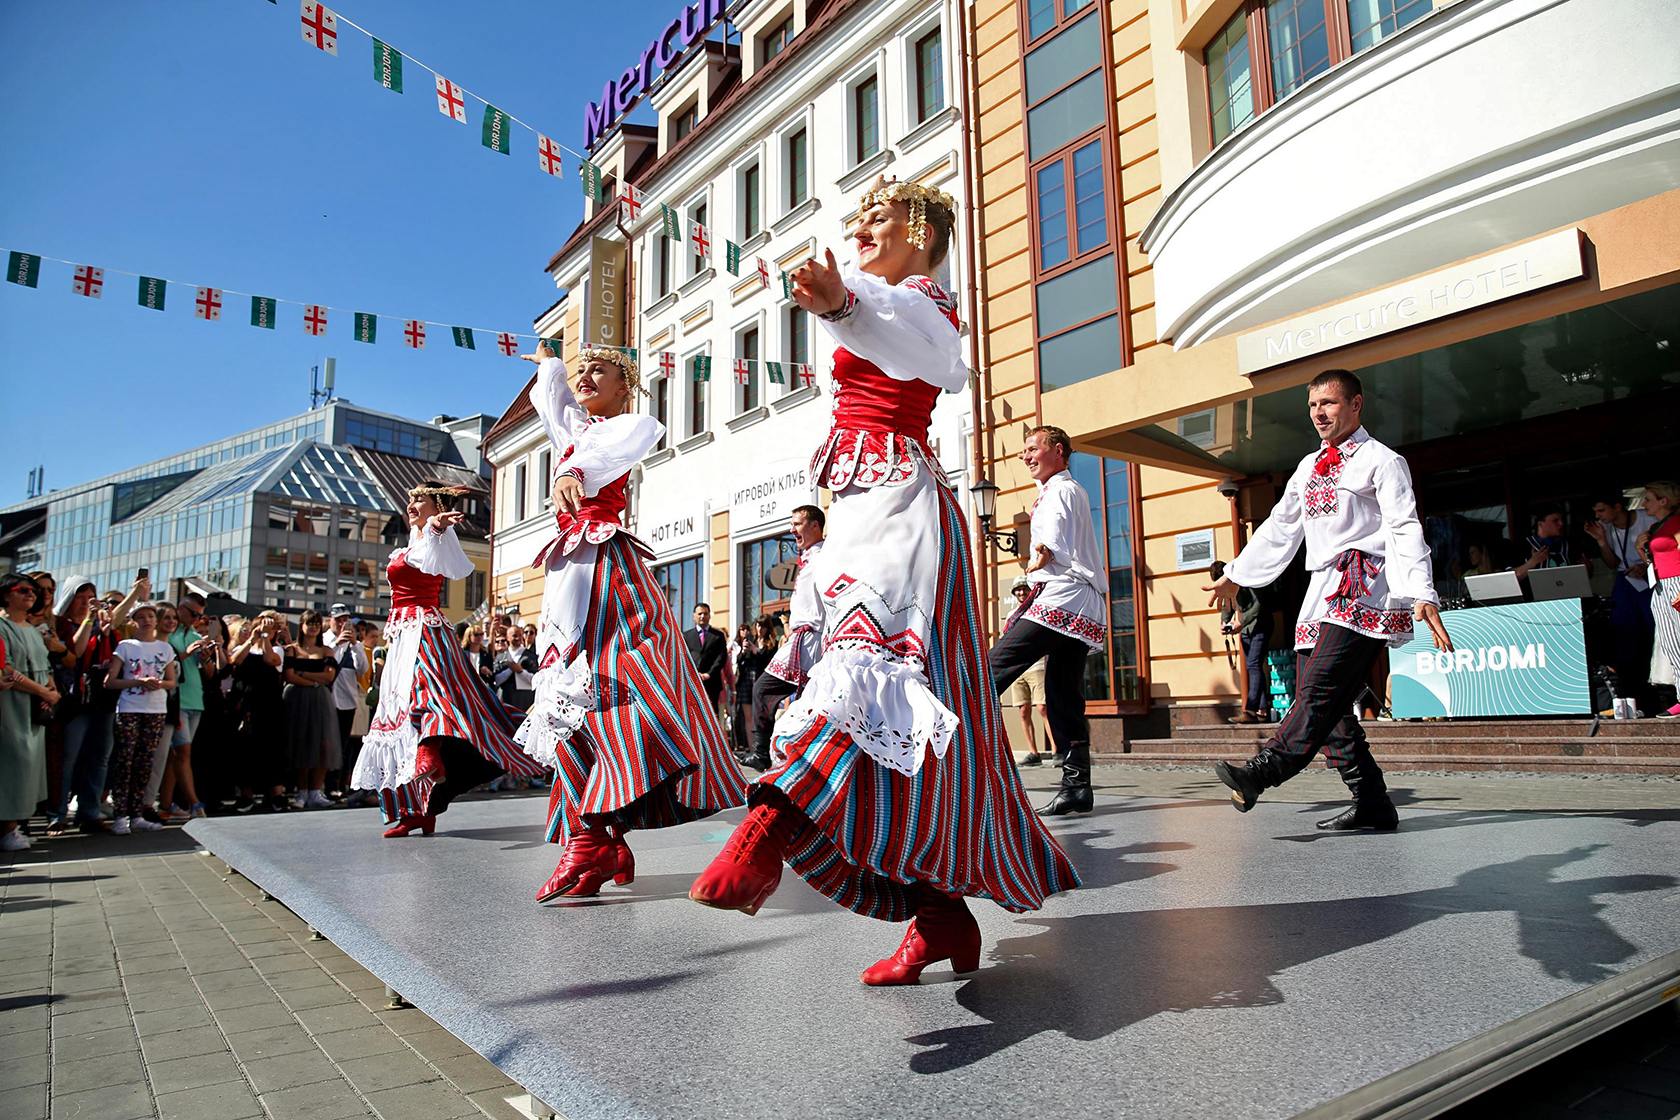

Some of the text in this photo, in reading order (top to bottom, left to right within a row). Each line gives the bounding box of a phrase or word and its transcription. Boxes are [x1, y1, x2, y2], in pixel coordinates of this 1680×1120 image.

[382, 43, 392, 89] BORJOMI
[491, 110, 503, 151] BORJOMI
[588, 162, 596, 200] BORJOMI
[666, 206, 675, 240] BORJOMI
[18, 253, 31, 285] BORJOMI
[147, 278, 158, 309] BORJOMI
[601, 256, 616, 319] HOTEL
[259, 297, 268, 327] BORJOMI
[1265, 260, 1543, 360] Mercure HOTEL
[361, 313, 370, 342] BORJOMI
[734, 470, 805, 506] ИГРОВОЙ КЛУБ
[760, 501, 776, 518] БАР
[651, 516, 693, 543] HOT FUN
[1415, 643, 1546, 675] BORJOMI
